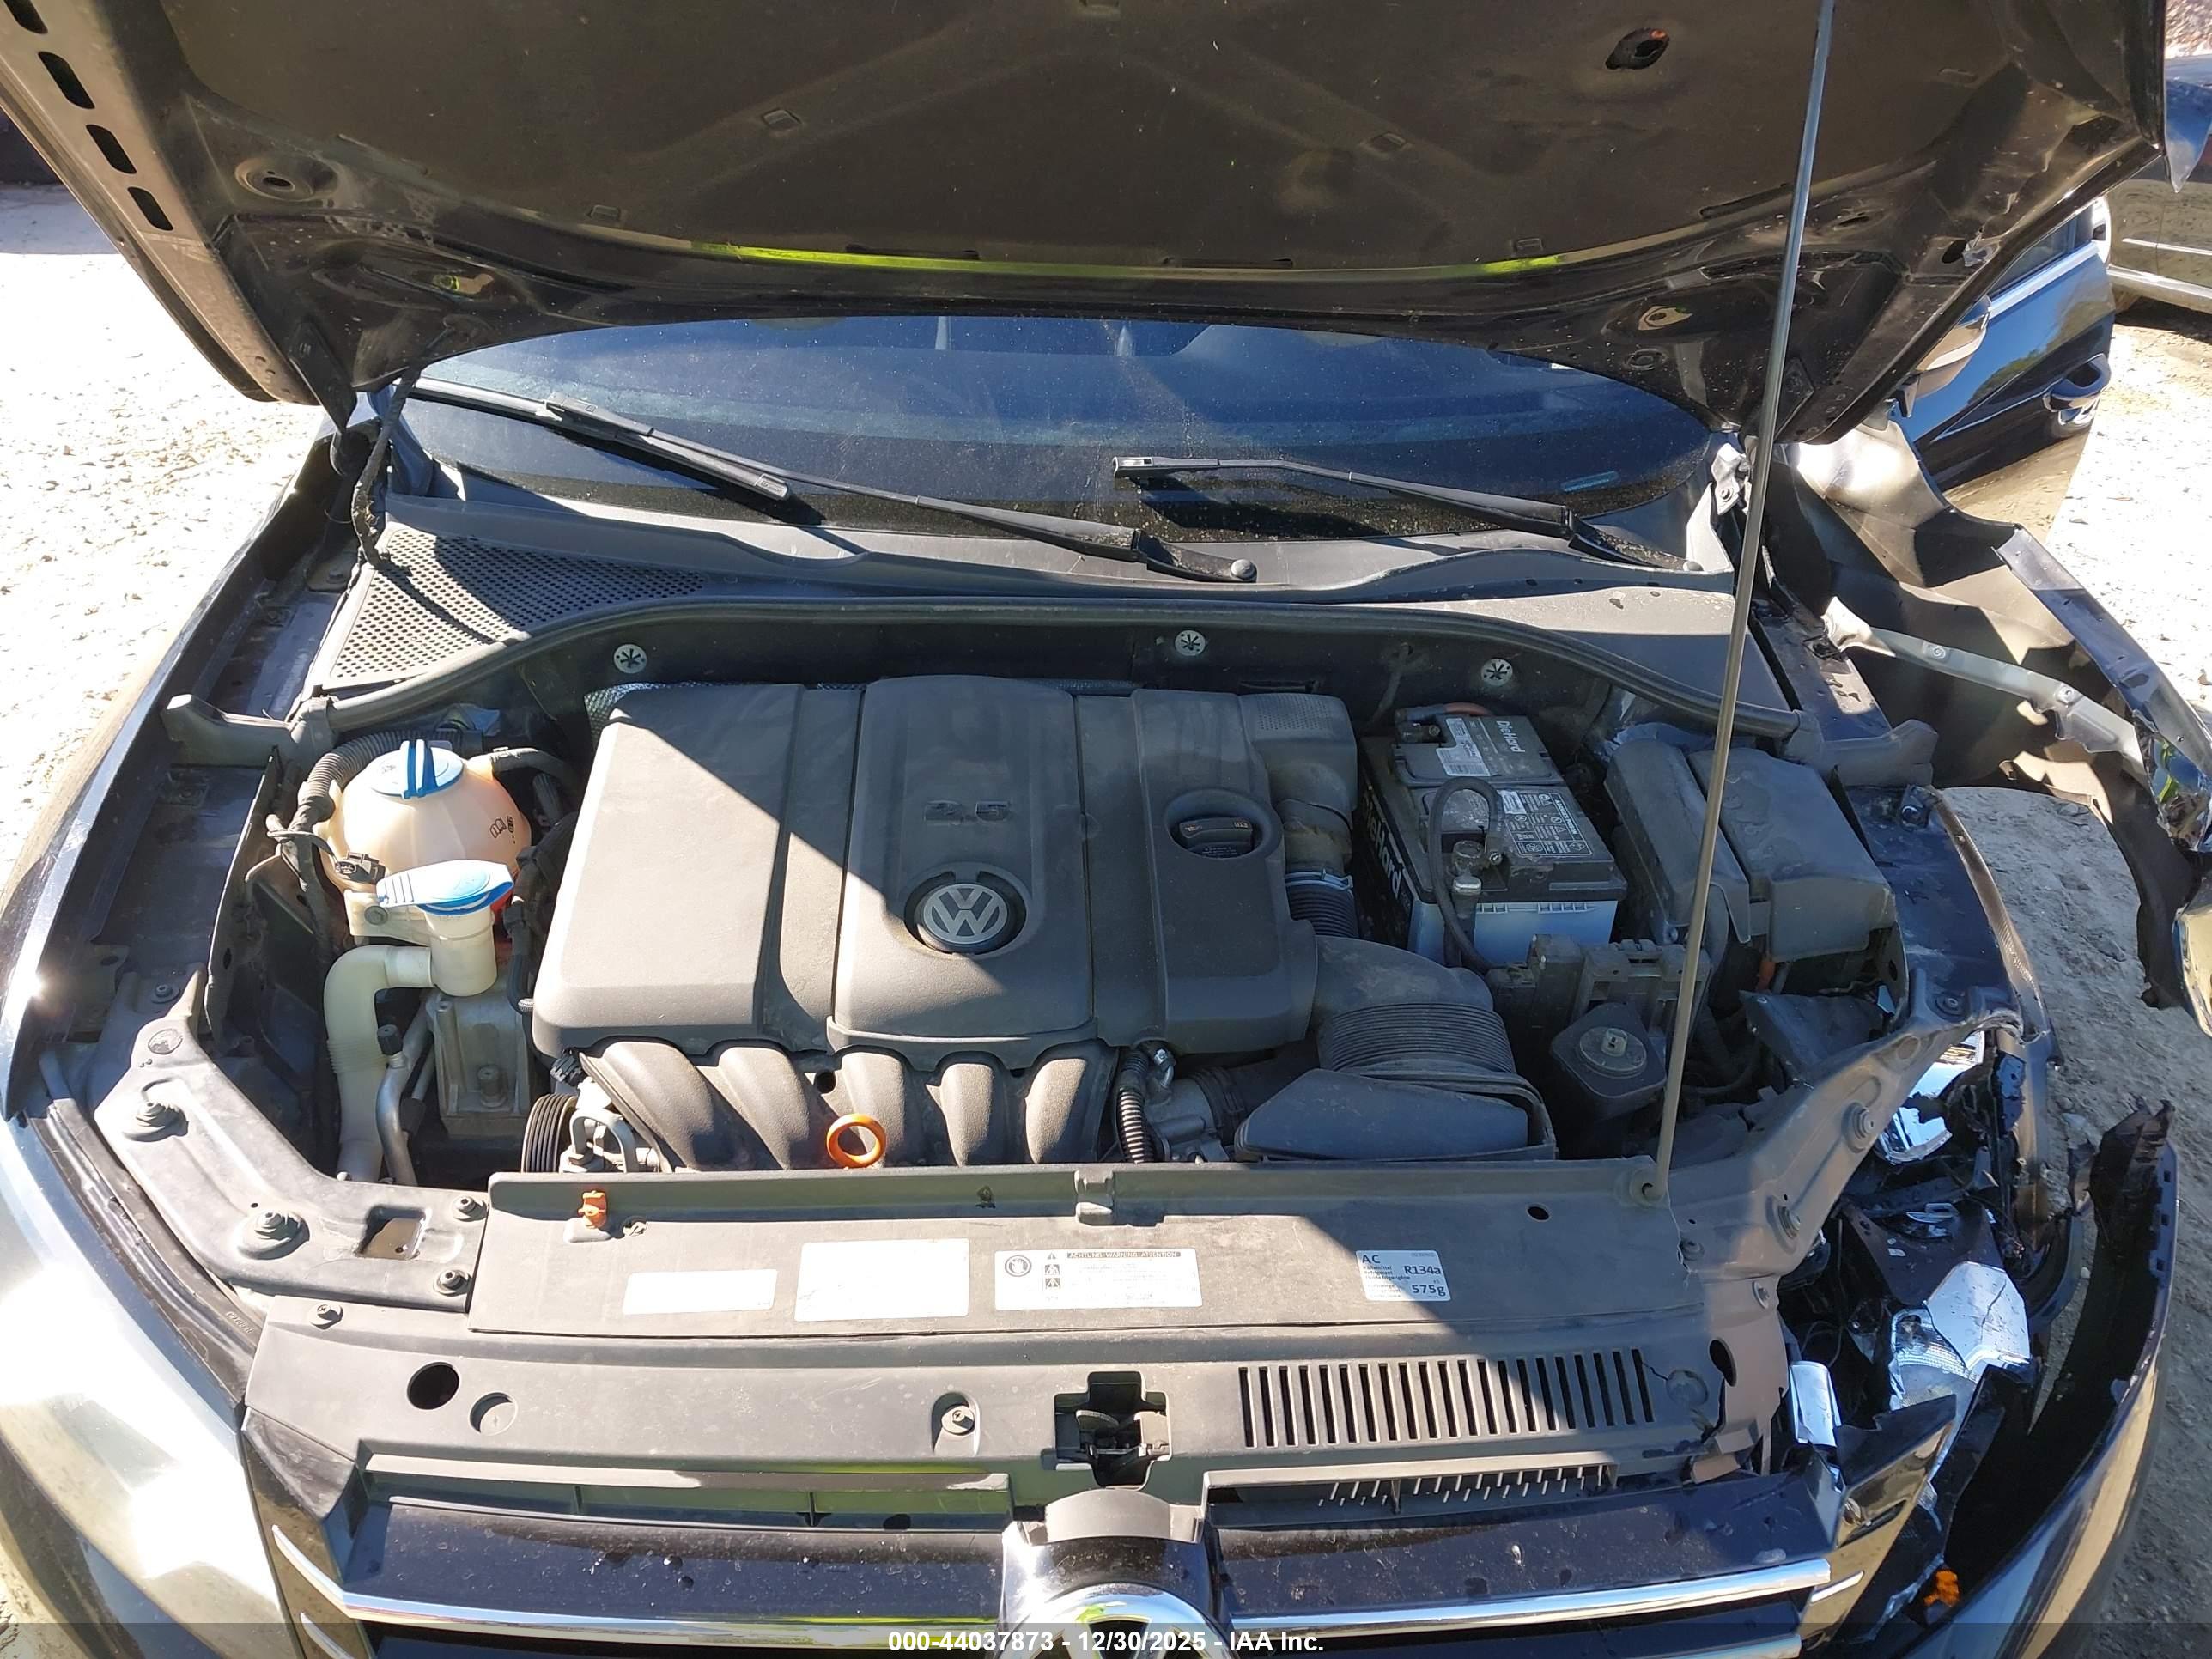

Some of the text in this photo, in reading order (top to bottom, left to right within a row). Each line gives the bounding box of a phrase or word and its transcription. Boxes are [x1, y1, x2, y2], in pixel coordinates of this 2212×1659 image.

[1496, 720, 1525, 753] DieHard
[1404, 1265, 1442, 1275] R134a
[1411, 1284, 1446, 1297] 575g
